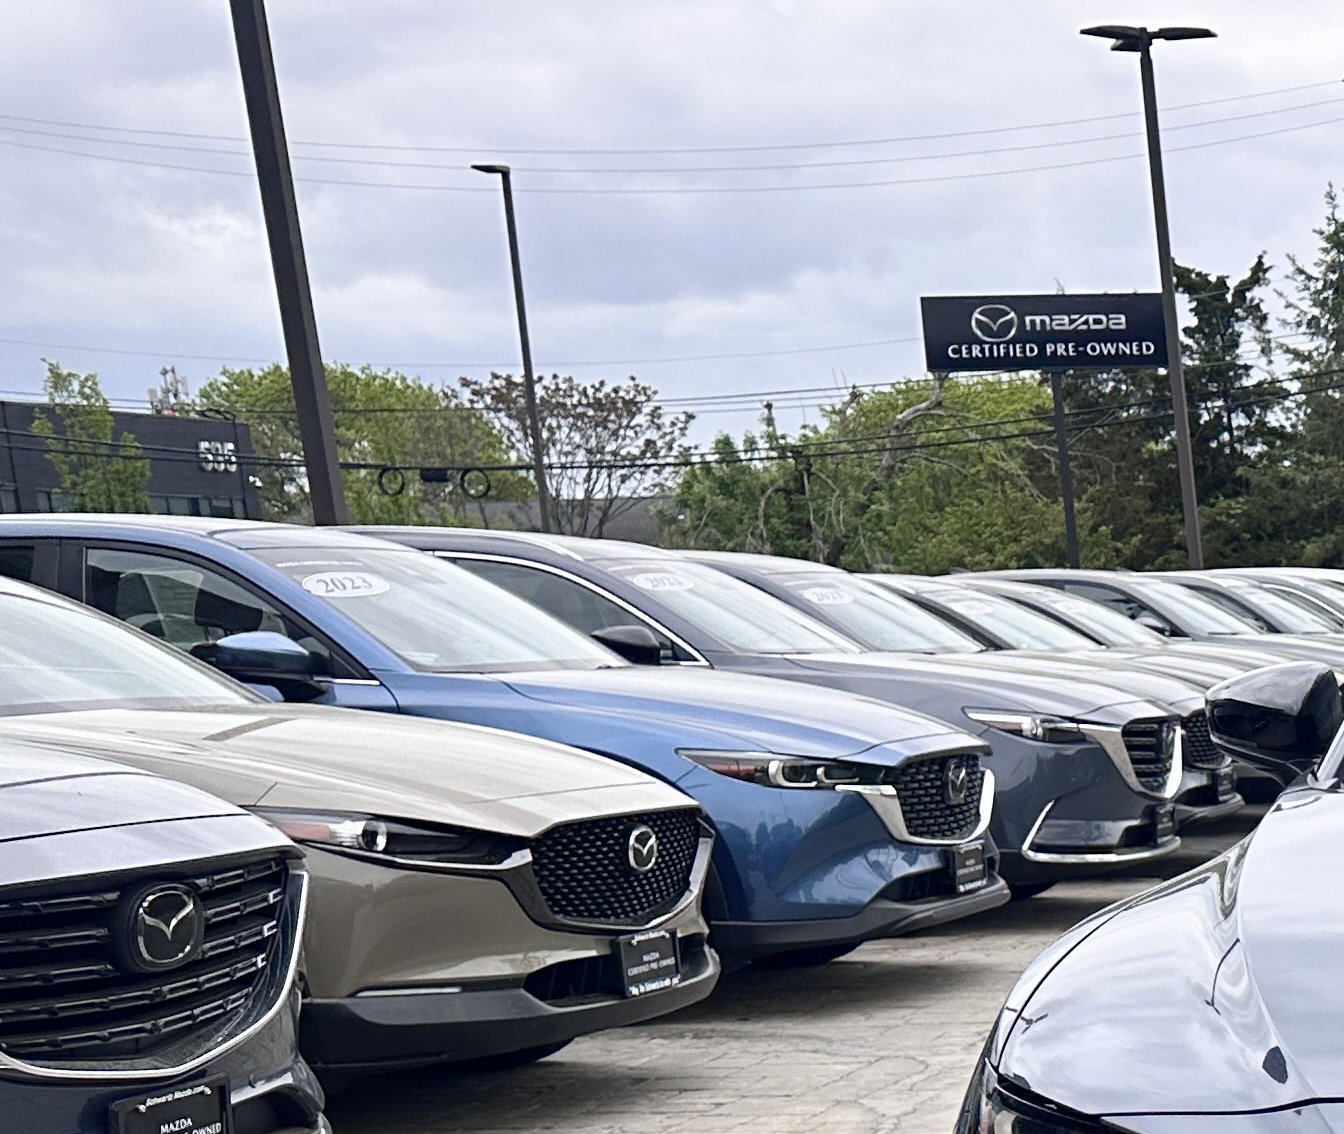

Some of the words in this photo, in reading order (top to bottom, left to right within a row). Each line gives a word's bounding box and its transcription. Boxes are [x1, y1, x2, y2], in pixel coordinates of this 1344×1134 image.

[1025, 313, 1127, 332] mazda
[948, 343, 1039, 359] CERTIFIED
[1046, 341, 1155, 357] PRE-OWNED
[316, 576, 373, 593] 2023
[160, 1117, 193, 1134] MAZDA
